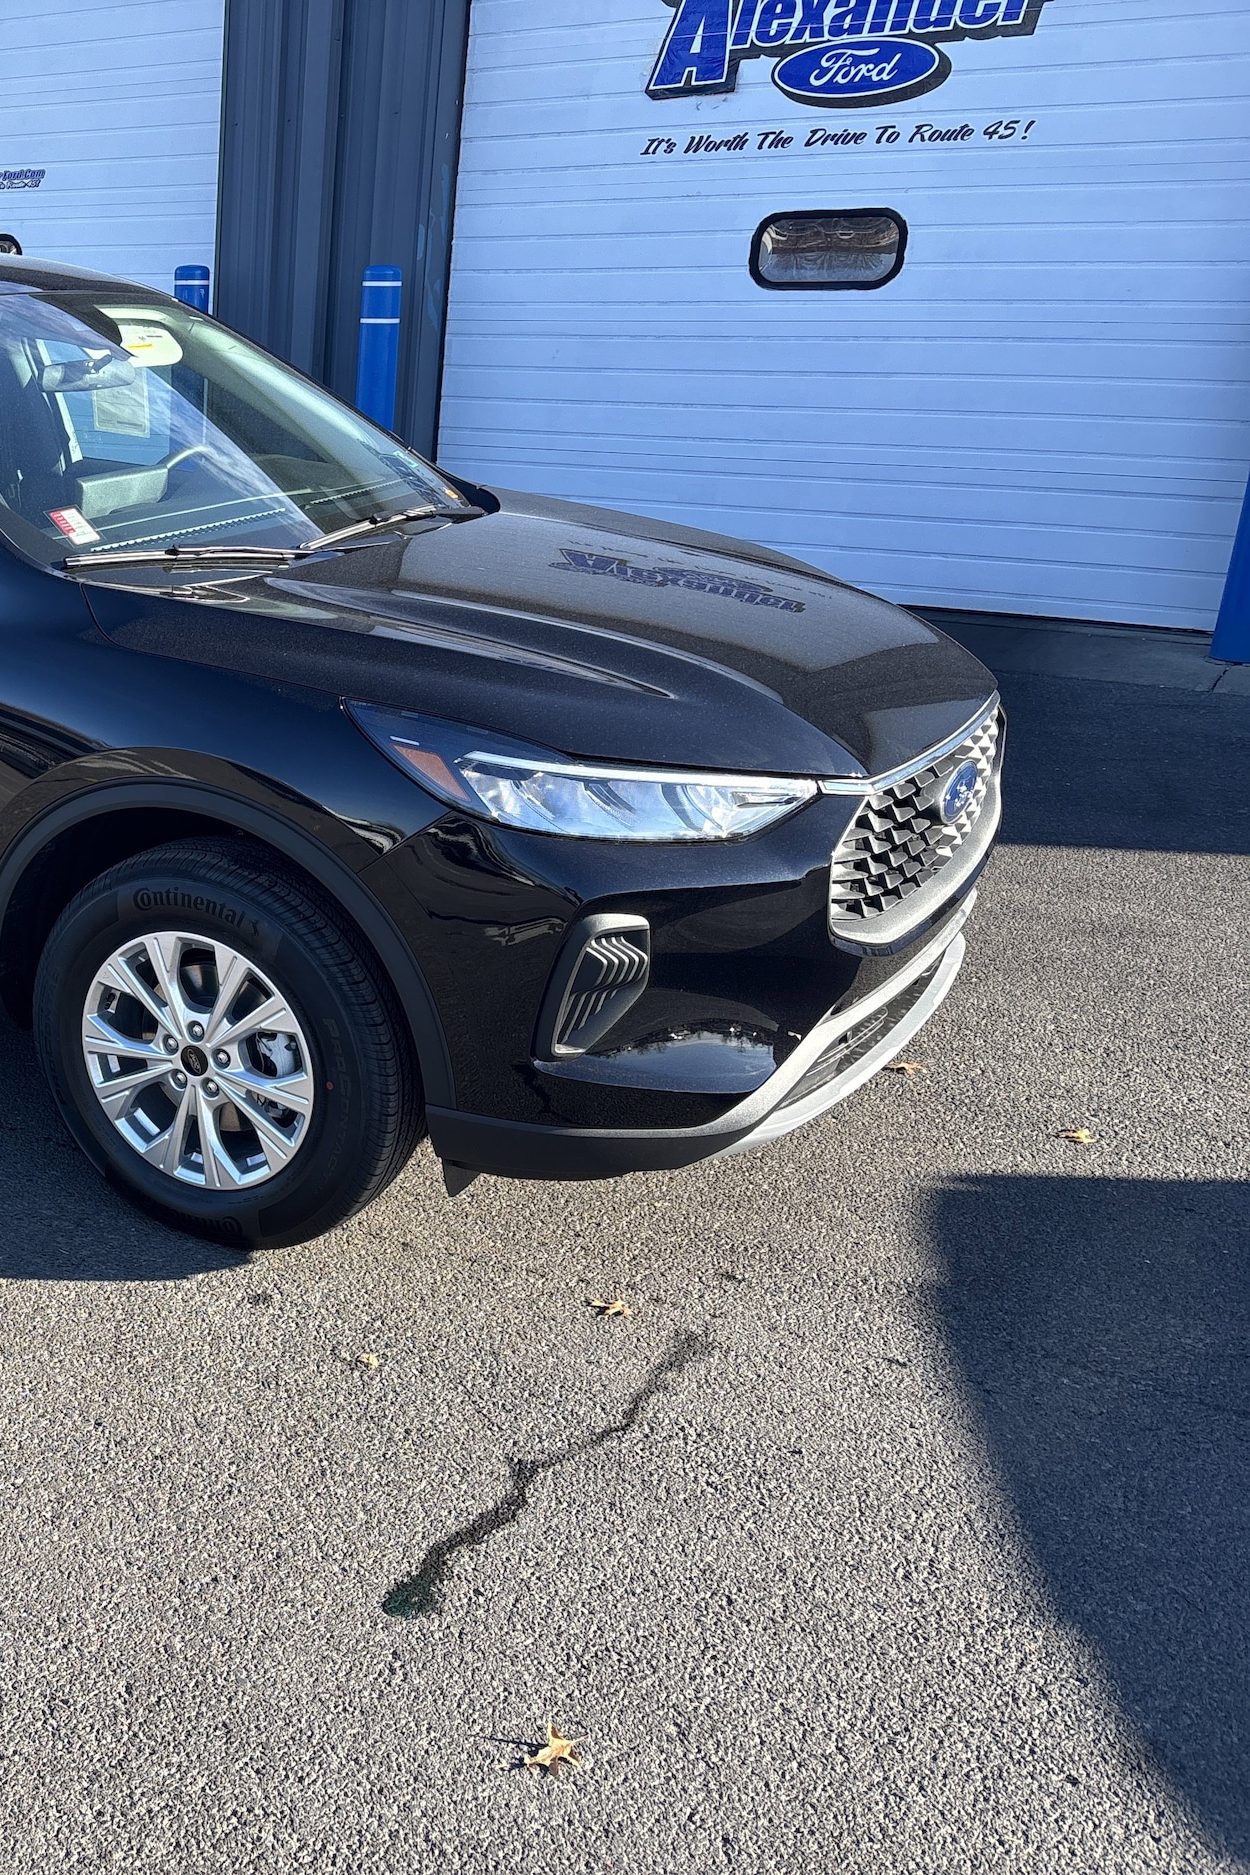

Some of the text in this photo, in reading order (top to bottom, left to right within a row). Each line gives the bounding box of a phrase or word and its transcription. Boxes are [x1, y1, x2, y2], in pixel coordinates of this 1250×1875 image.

[810, 48, 902, 86] Ford
[639, 137, 677, 155] It's
[683, 131, 749, 154] Worth
[757, 129, 794, 150] The
[804, 128, 868, 147] Drive
[875, 124, 900, 144] To
[908, 123, 976, 143] Route
[133, 886, 246, 929] Continental
